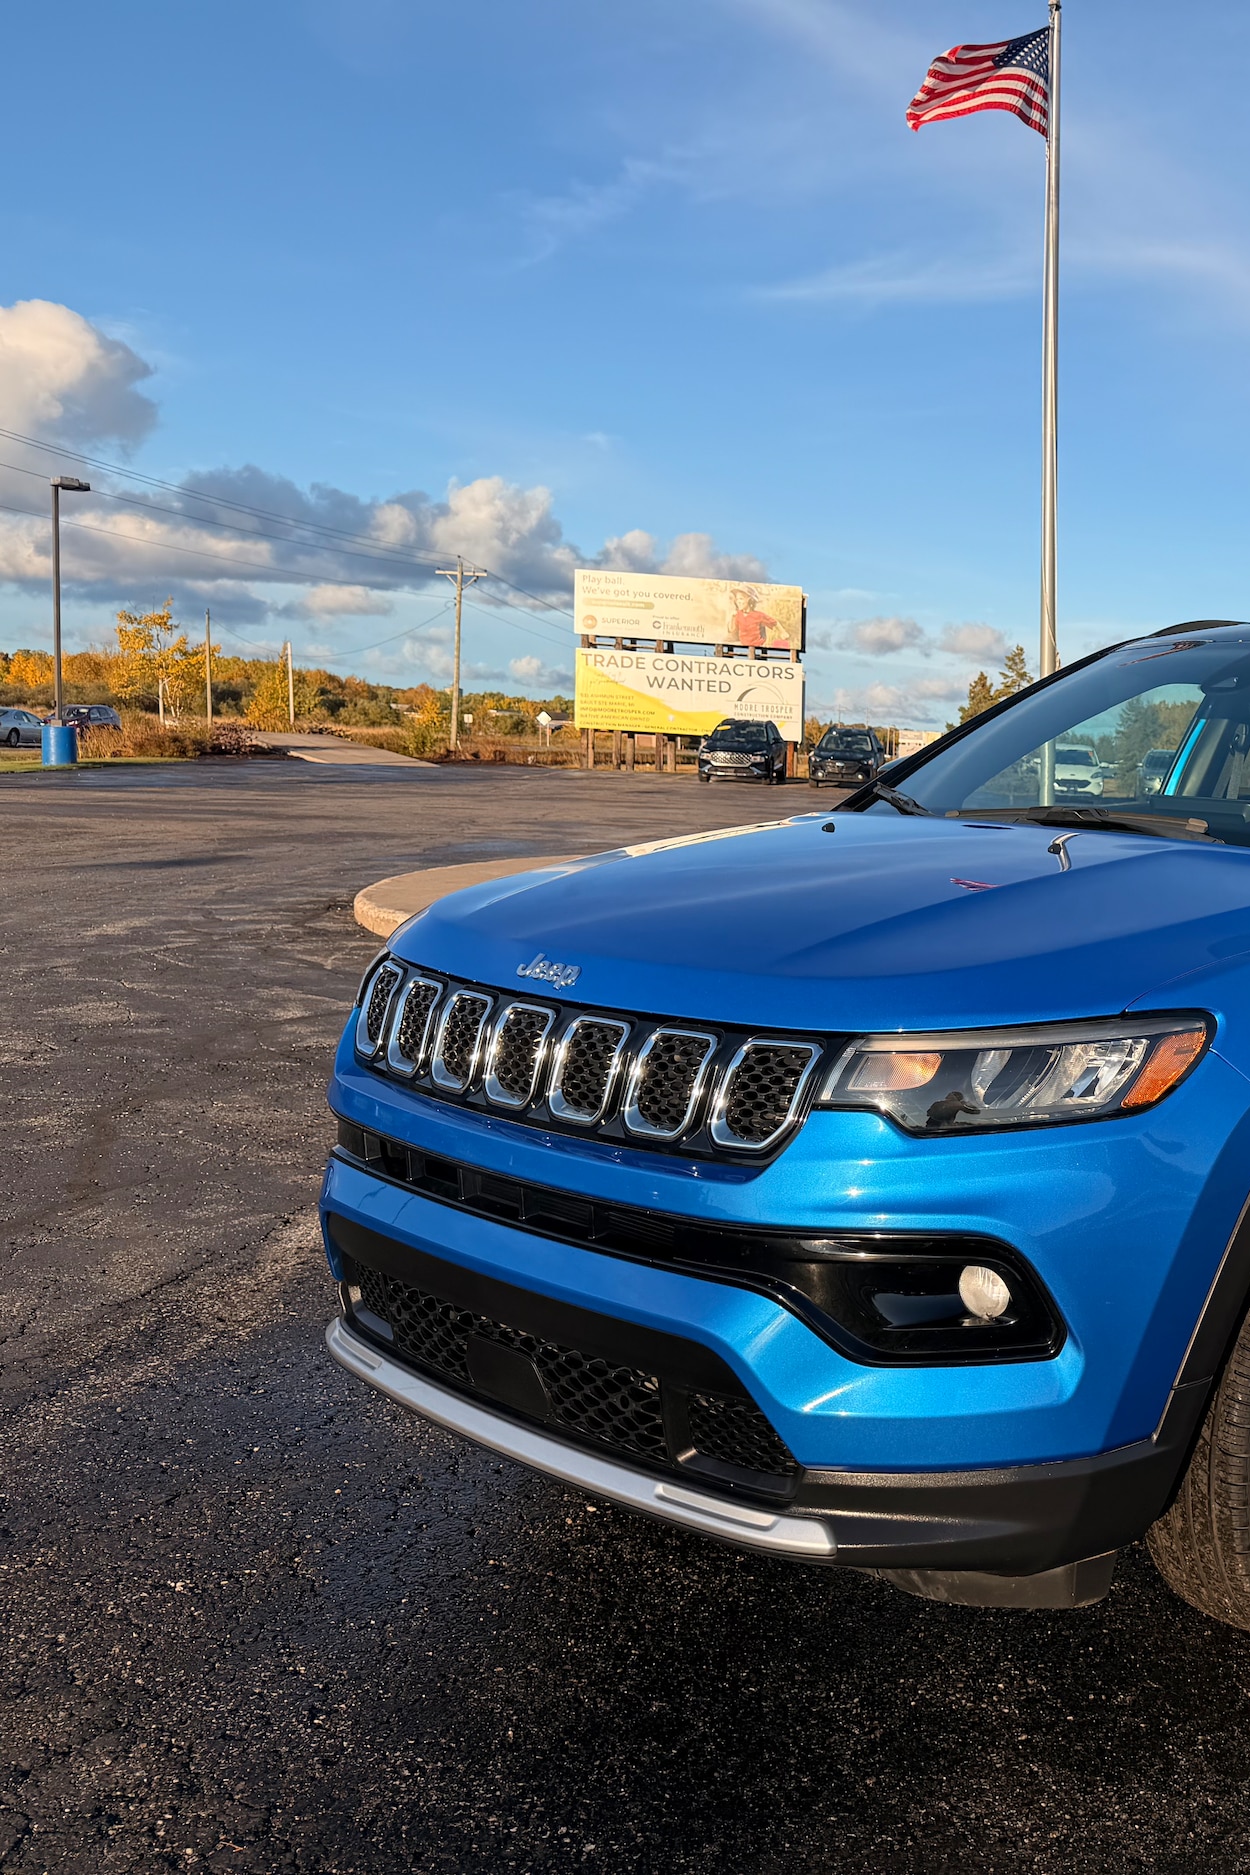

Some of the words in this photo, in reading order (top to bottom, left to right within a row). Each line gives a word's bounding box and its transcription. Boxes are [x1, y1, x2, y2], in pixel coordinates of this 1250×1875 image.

[582, 574, 601, 585] Play
[605, 576, 625, 585] ball.
[582, 586, 611, 595] We've
[614, 589, 630, 597] got
[633, 590, 651, 599] you
[653, 591, 694, 601] covered.
[601, 617, 640, 626] SUPERIOR
[580, 652, 646, 670] TRADE
[652, 657, 795, 680] CONTRACTORS
[646, 675, 732, 693] WANTED
[734, 703, 757, 712] MOORE
[762, 705, 793, 714] TROSPER
[516, 952, 581, 991] Jeep
